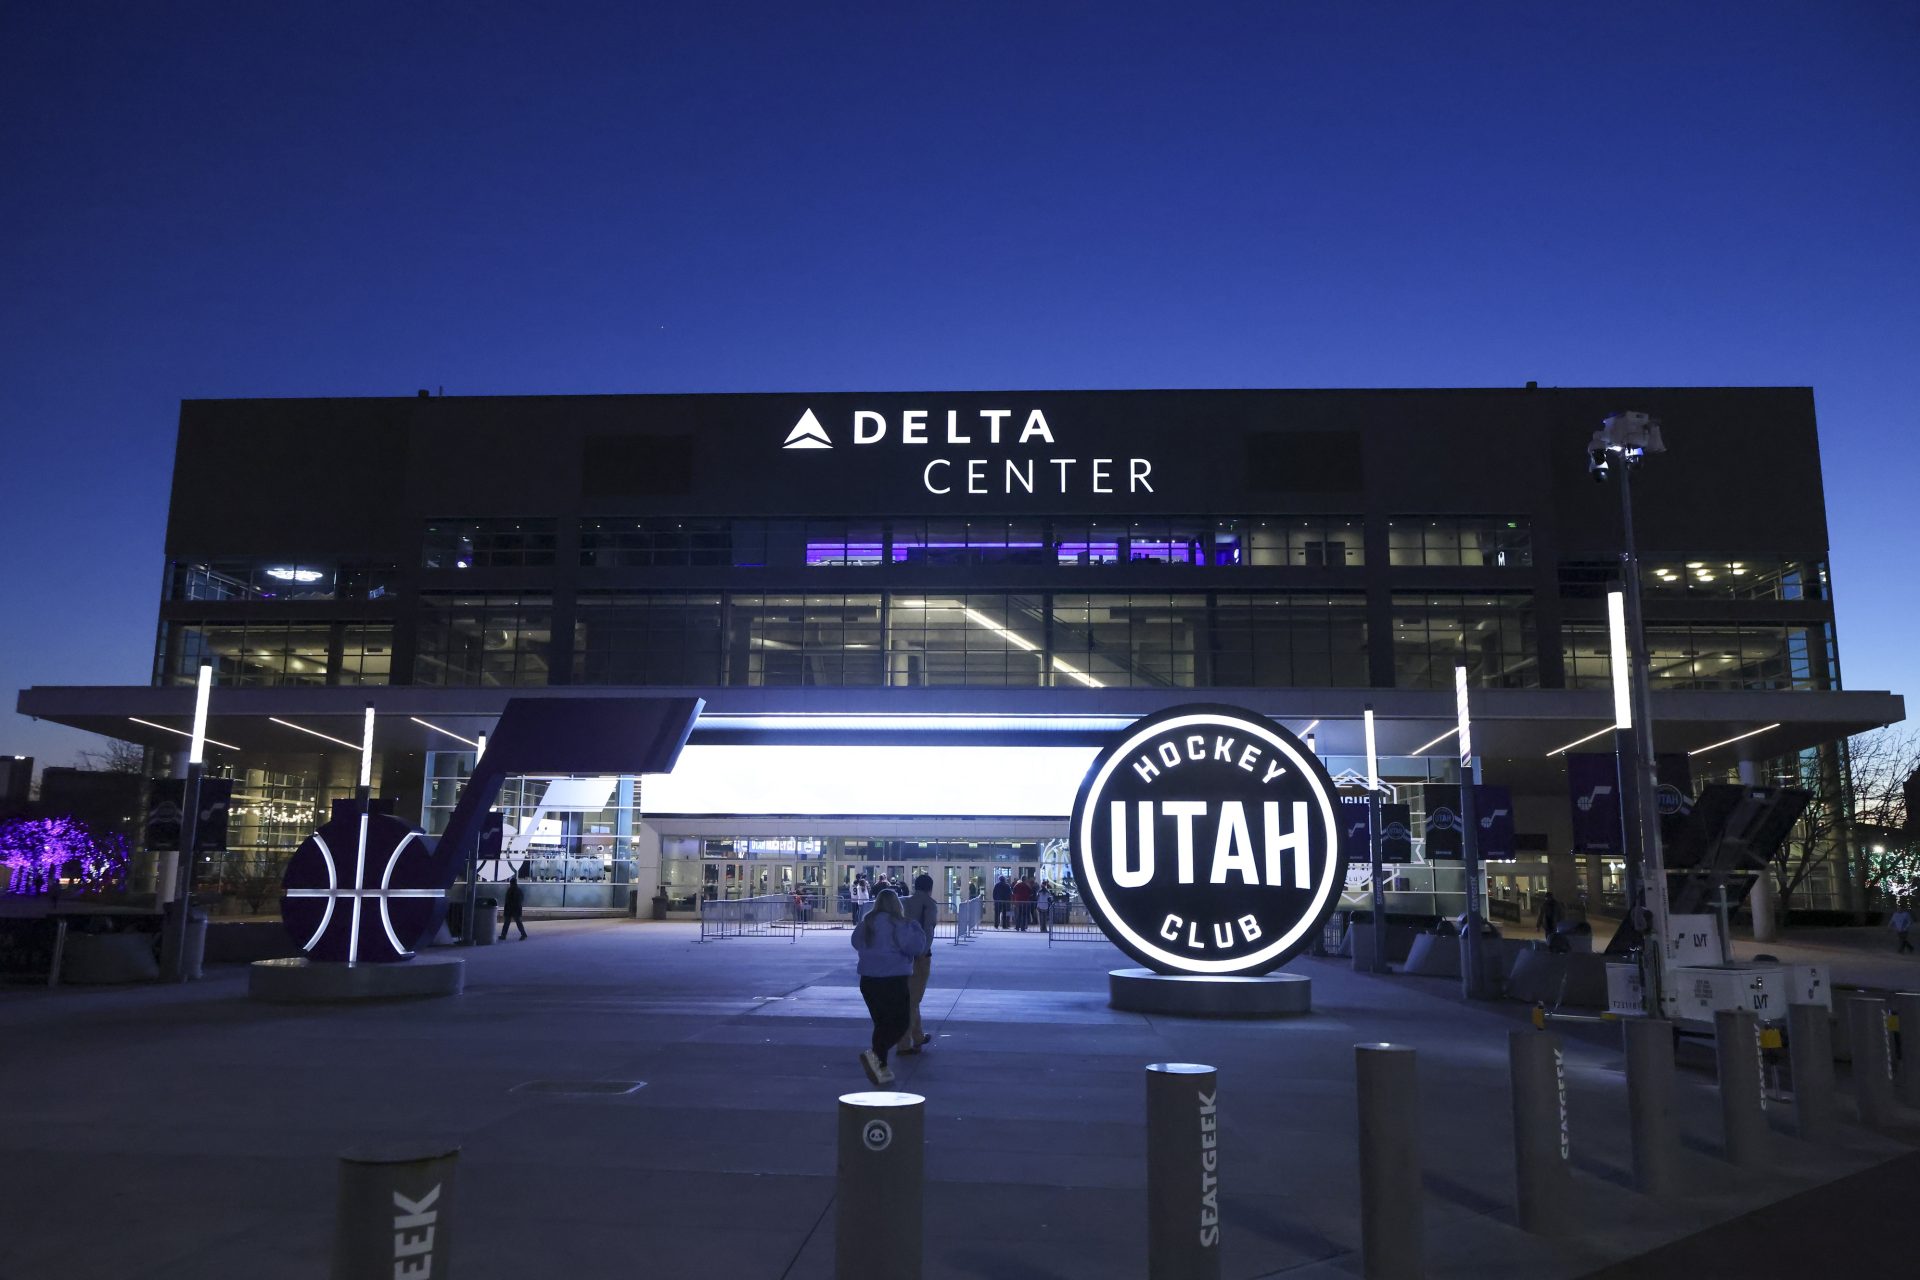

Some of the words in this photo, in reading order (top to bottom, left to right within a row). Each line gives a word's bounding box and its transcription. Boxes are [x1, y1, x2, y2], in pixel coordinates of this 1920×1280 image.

[853, 408, 1055, 444] DELTA
[923, 458, 1154, 495] CENTER
[1132, 735, 1286, 784] HOCKEY
[1110, 800, 1311, 890] UTAH
[1160, 913, 1262, 949] CLUB
[1693, 933, 1708, 947] LVT
[1753, 994, 1768, 1009] LVT
[1198, 1089, 1219, 1248] SEATGEEK
[394, 1182, 441, 1280] EEK
